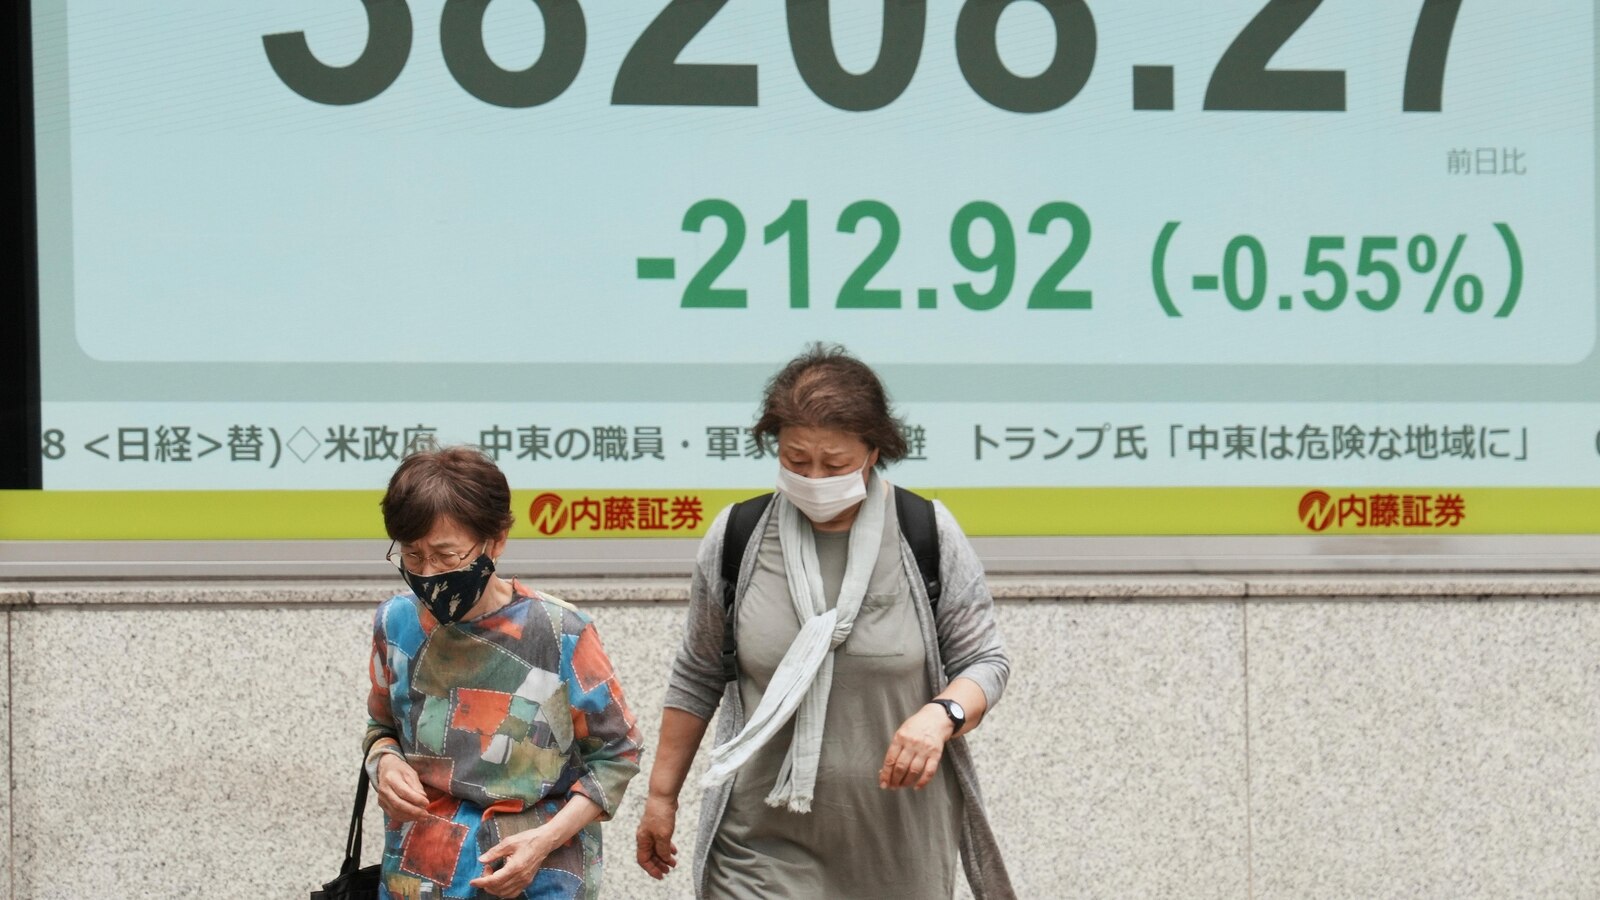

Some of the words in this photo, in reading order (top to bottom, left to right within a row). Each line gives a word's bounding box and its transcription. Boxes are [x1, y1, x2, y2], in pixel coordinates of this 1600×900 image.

[1447, 147, 1527, 176] 前日比
[634, 198, 1094, 312] -212.92
[1150, 220, 1525, 319] (-0.55%)
[571, 495, 703, 531] 内藤証券
[1337, 494, 1466, 528] 内藤証券
